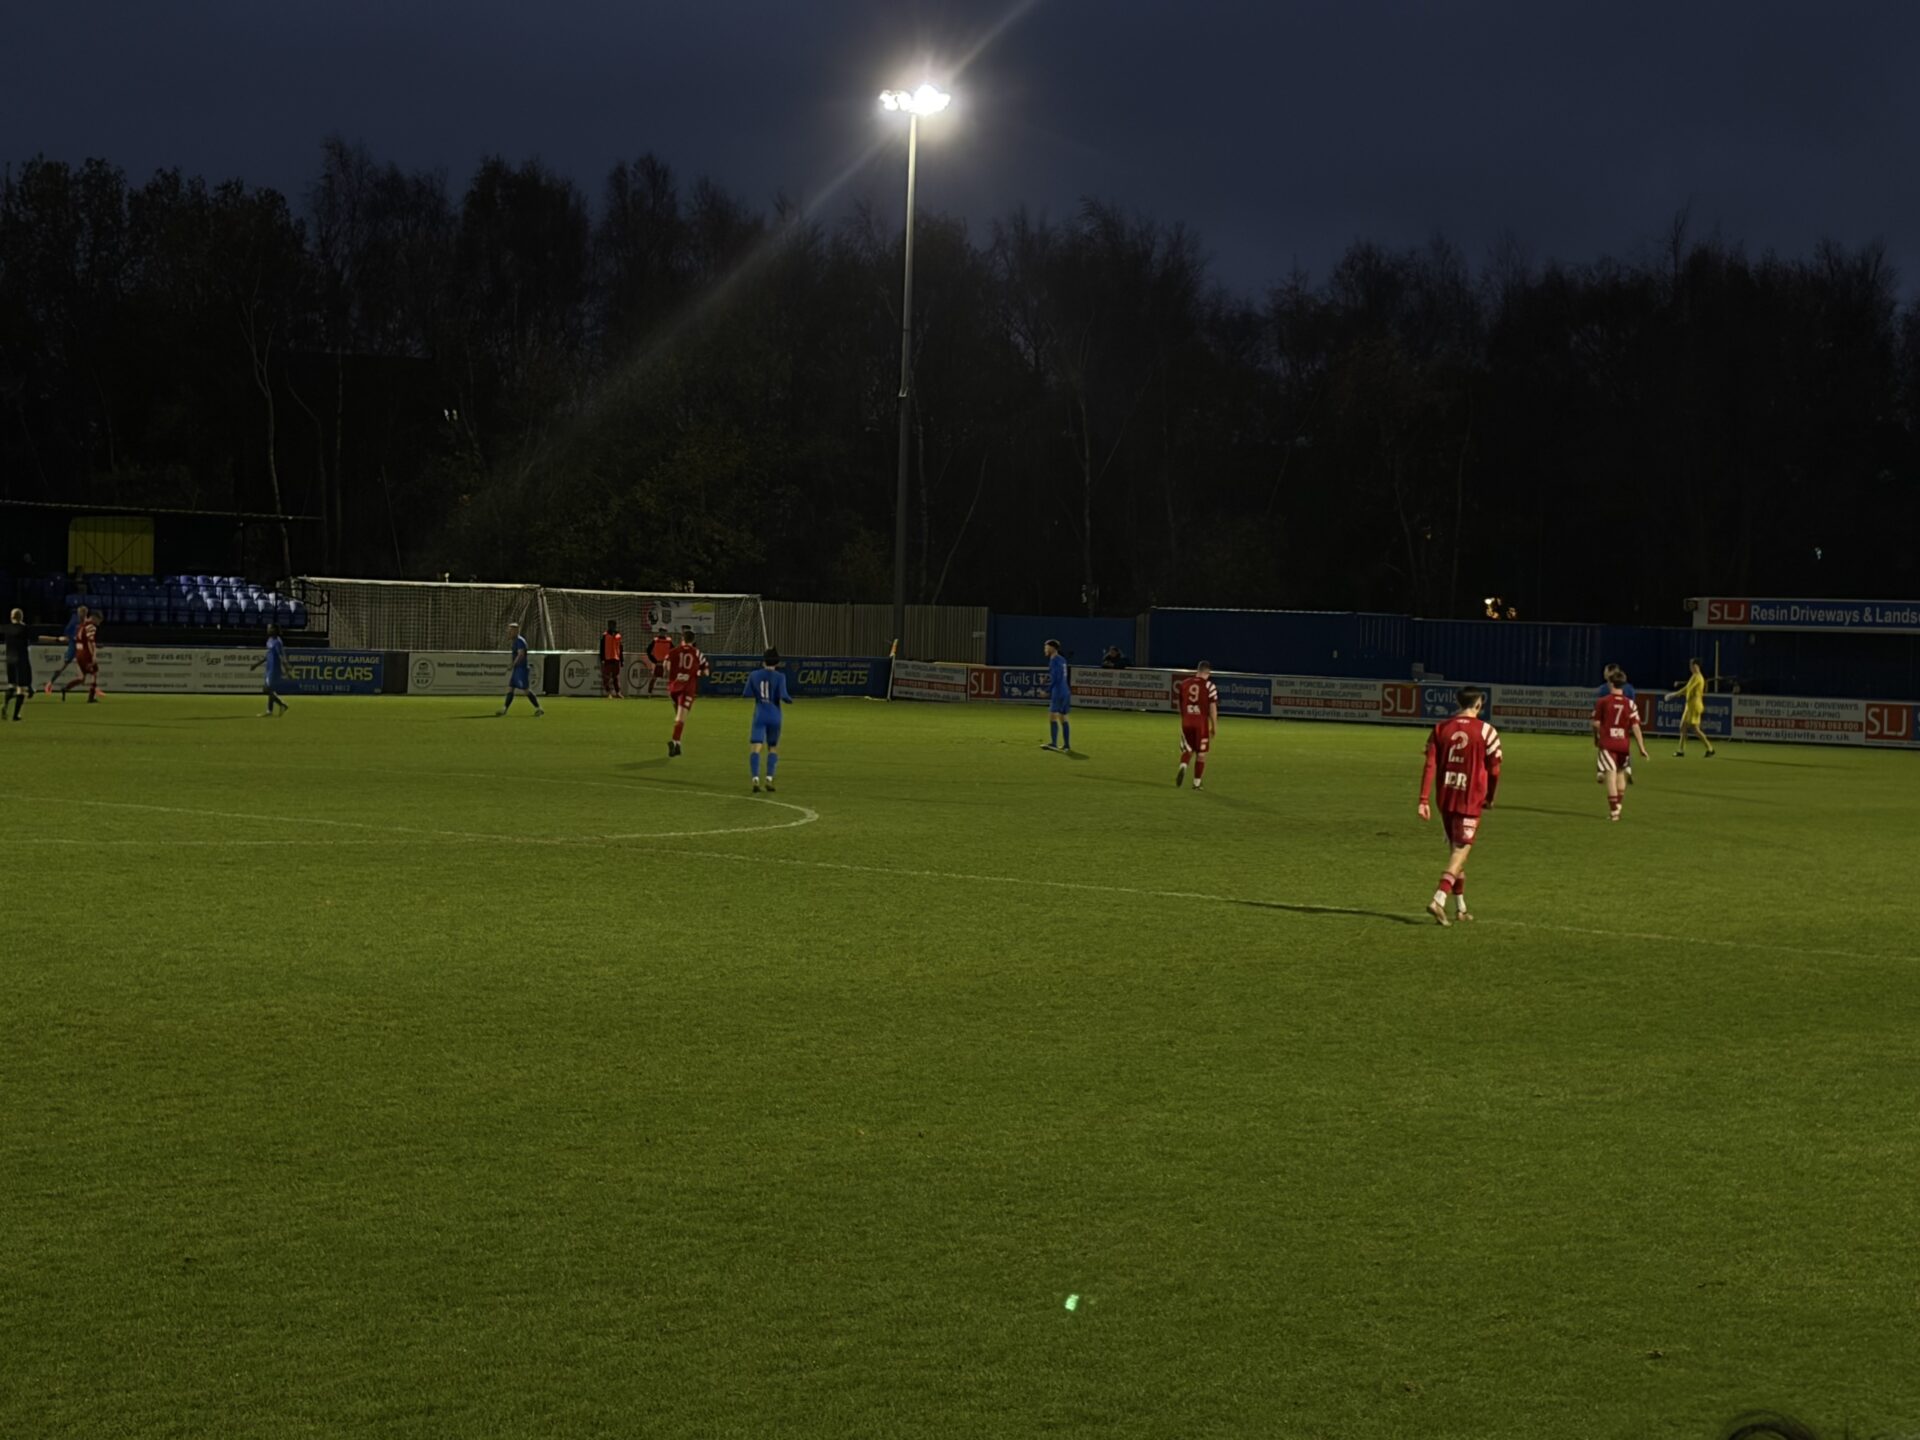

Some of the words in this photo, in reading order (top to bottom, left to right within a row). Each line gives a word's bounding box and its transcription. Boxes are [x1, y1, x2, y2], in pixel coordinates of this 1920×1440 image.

[1709, 602, 1745, 621] SLJ
[1751, 605, 1788, 621] Resin
[1791, 606, 1860, 626] Driveways
[1864, 607, 1873, 622] &
[679, 652, 693, 670] 10
[336, 666, 374, 681] CARS
[798, 670, 828, 685] CAM
[830, 670, 868, 685] BELTS
[1003, 672, 1029, 686] Civils
[970, 671, 998, 695] SLJ
[1188, 684, 1200, 702] 9
[1382, 687, 1416, 714] SLJ
[1738, 698, 1761, 707] RESIN
[1766, 700, 1809, 710] PORCELAIN
[1814, 701, 1859, 711] DRIVEWAYS
[1613, 704, 1625, 725] 7
[1787, 710, 1841, 719] LANDSCAPING
[1867, 707, 1908, 737] SLJ
[1450, 731, 1469, 763] 2
